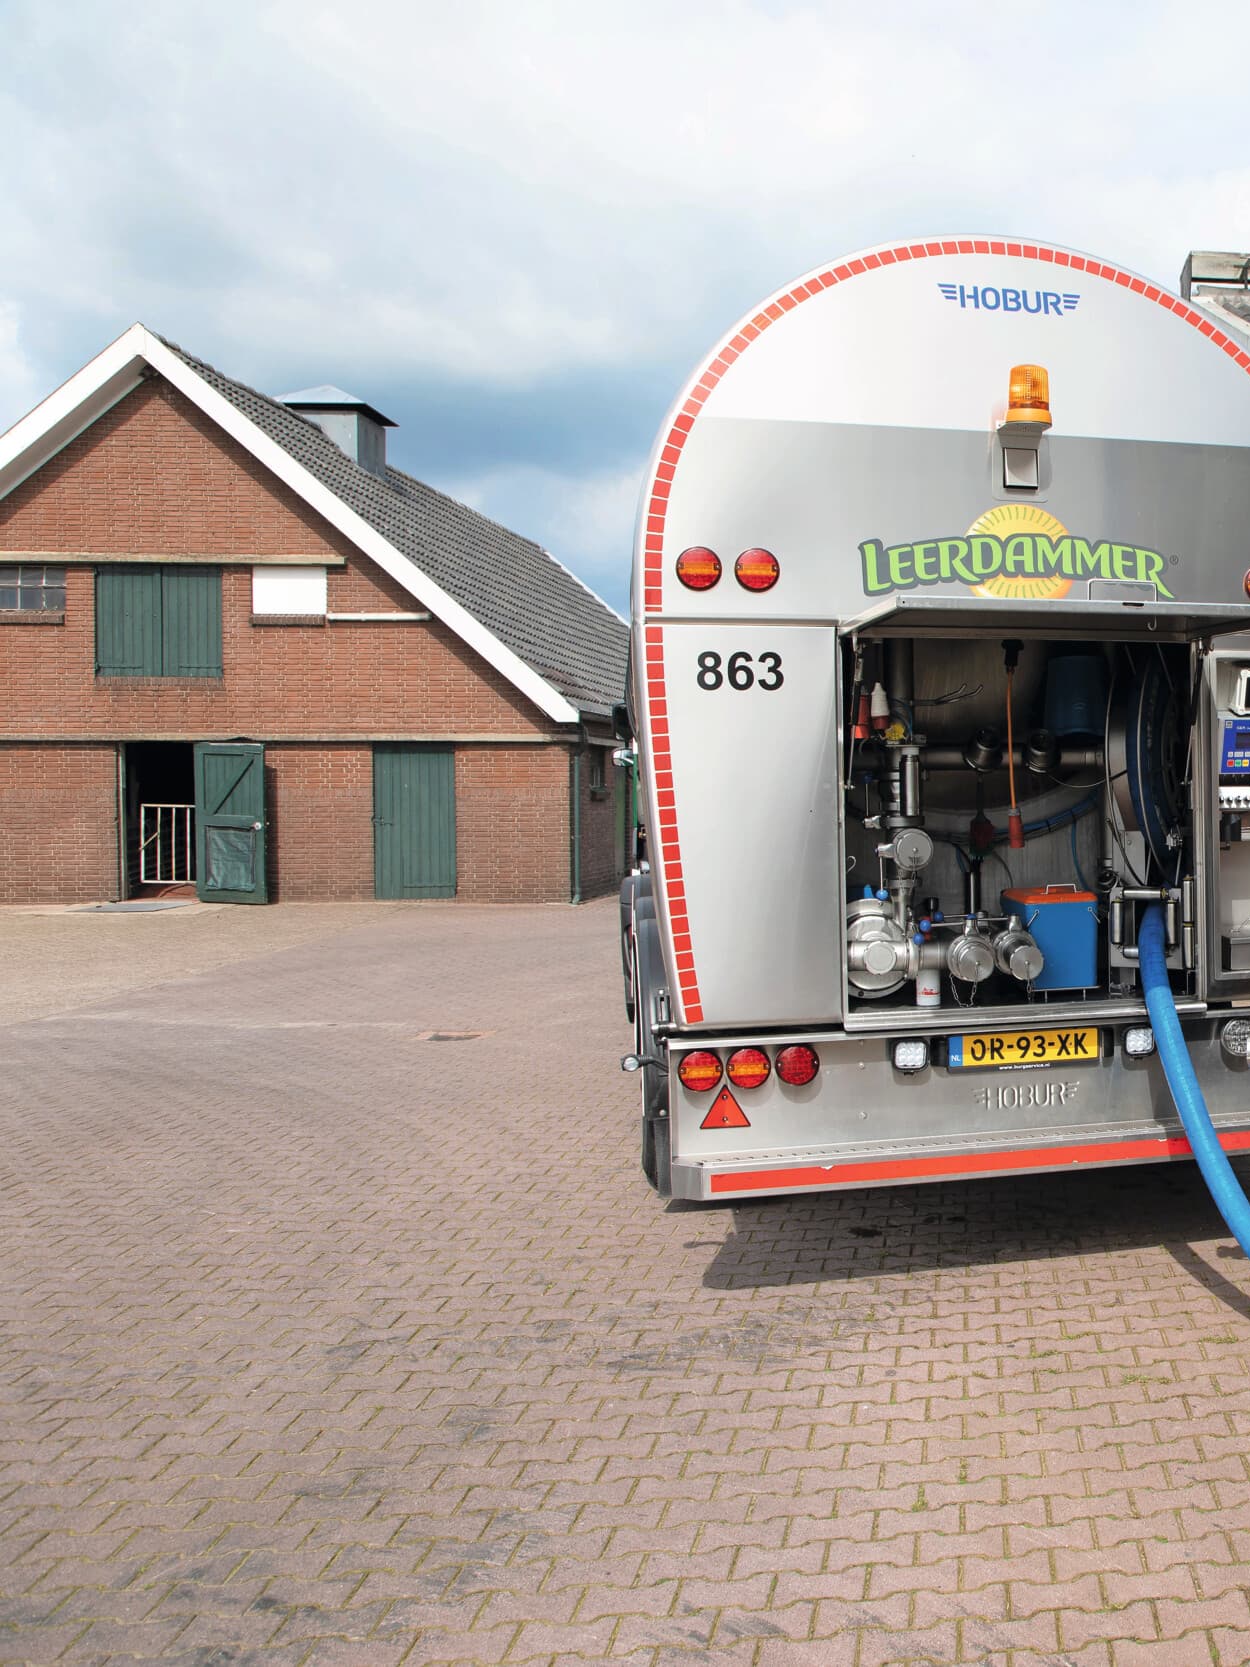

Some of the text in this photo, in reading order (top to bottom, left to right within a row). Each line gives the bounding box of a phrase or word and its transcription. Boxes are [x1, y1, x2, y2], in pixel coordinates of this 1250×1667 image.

[959, 285, 1064, 316] HOBUR
[860, 534, 1176, 599] LEERDAMMER
[697, 651, 784, 691] 863
[970, 1033, 1089, 1062] OR-93-XK
[985, 1080, 1066, 1110] HOBUR
